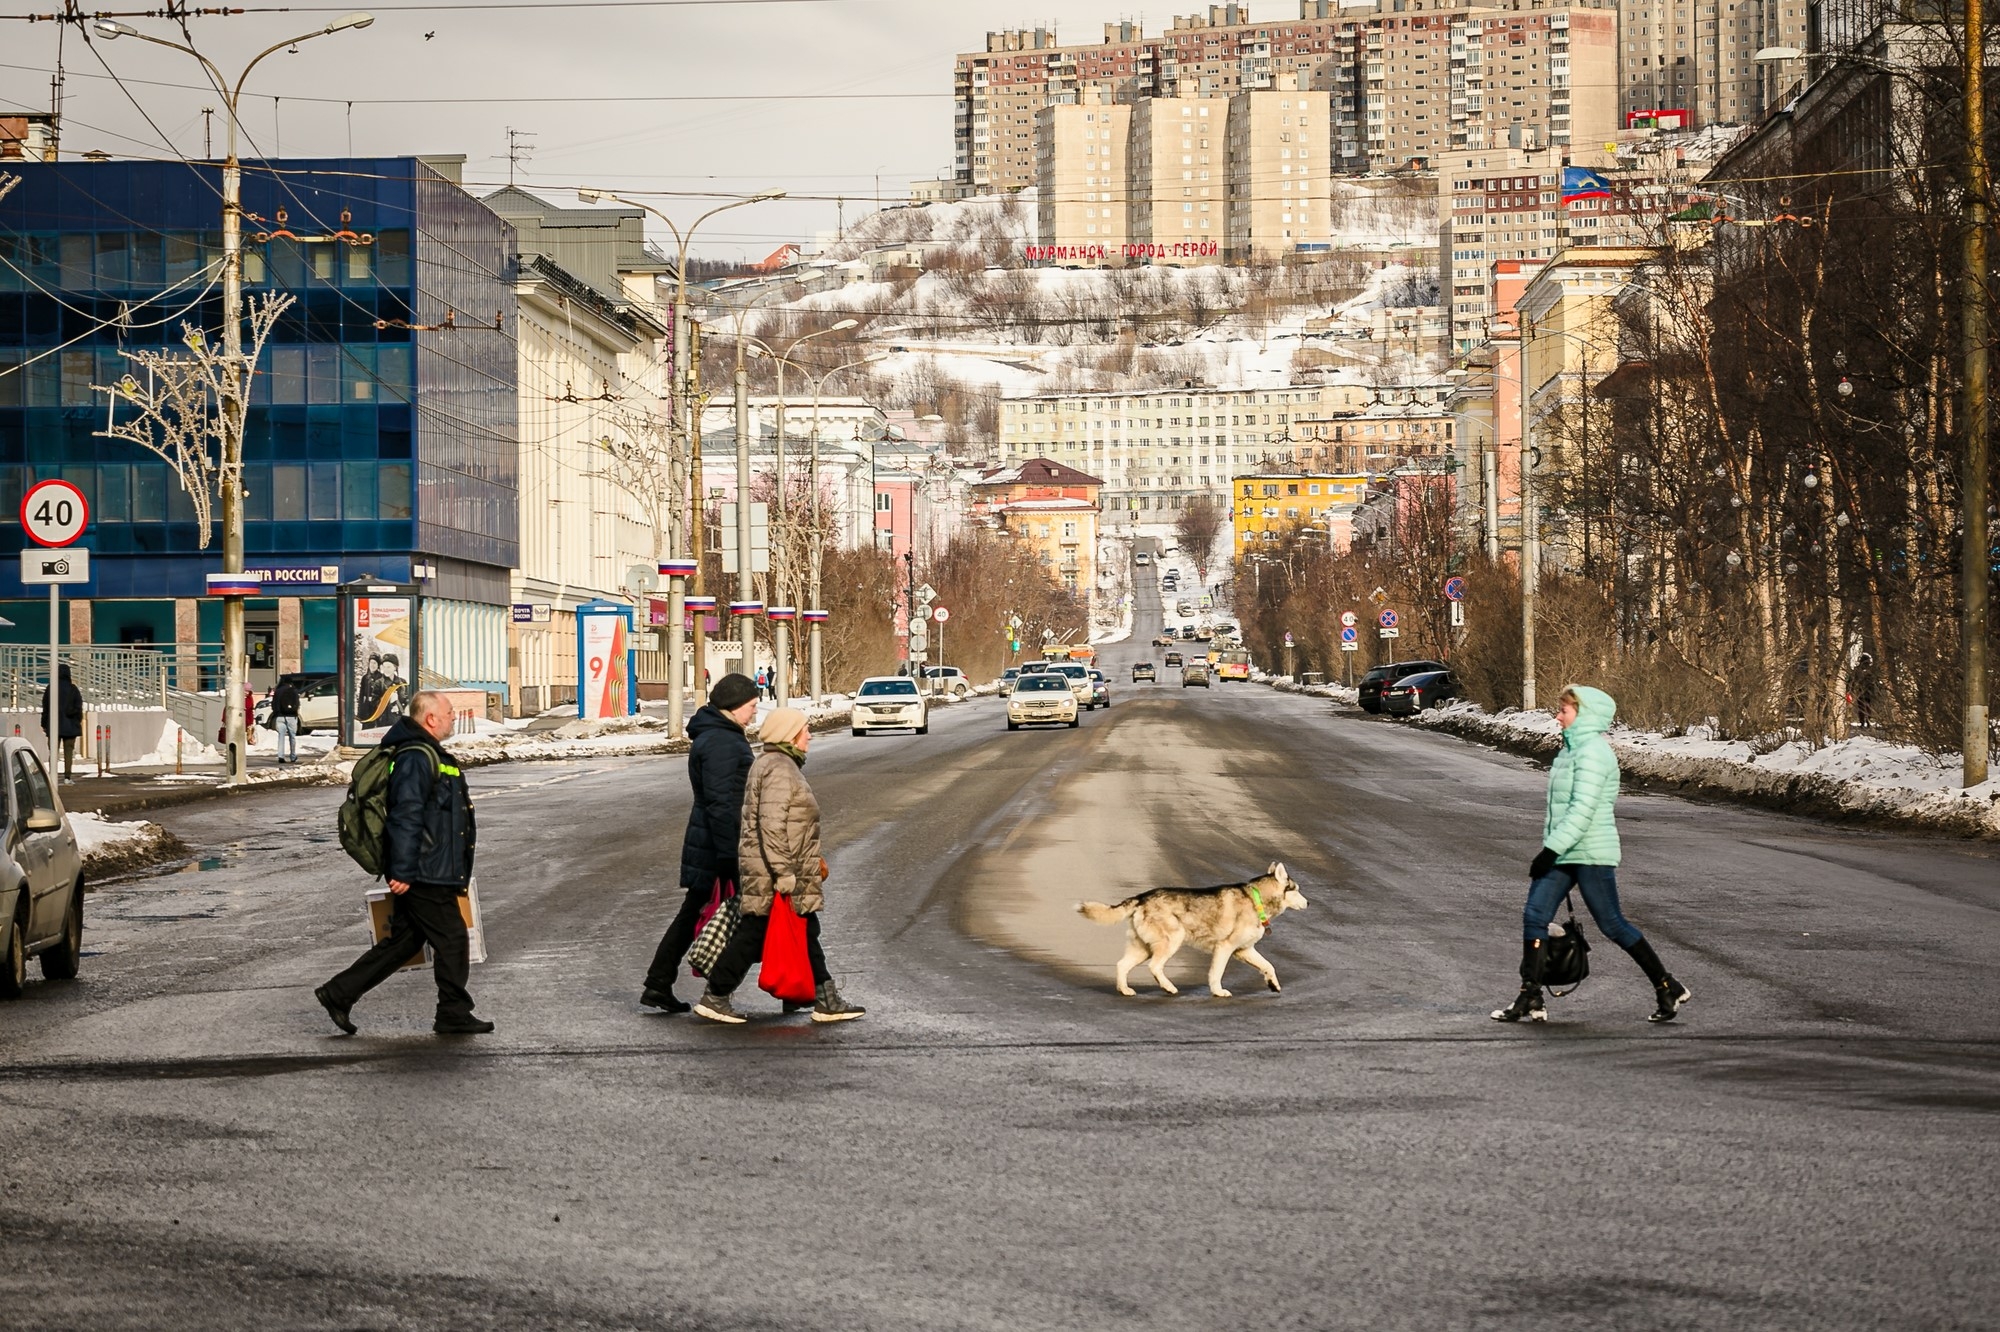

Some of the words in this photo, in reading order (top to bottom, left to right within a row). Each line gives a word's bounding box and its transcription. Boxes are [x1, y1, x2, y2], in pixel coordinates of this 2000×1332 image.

[1026, 245, 1105, 260] МУРМАНСК
[34, 500, 73, 526] 40
[275, 569, 319, 581] РОССИИ
[589, 656, 603, 679] 9
